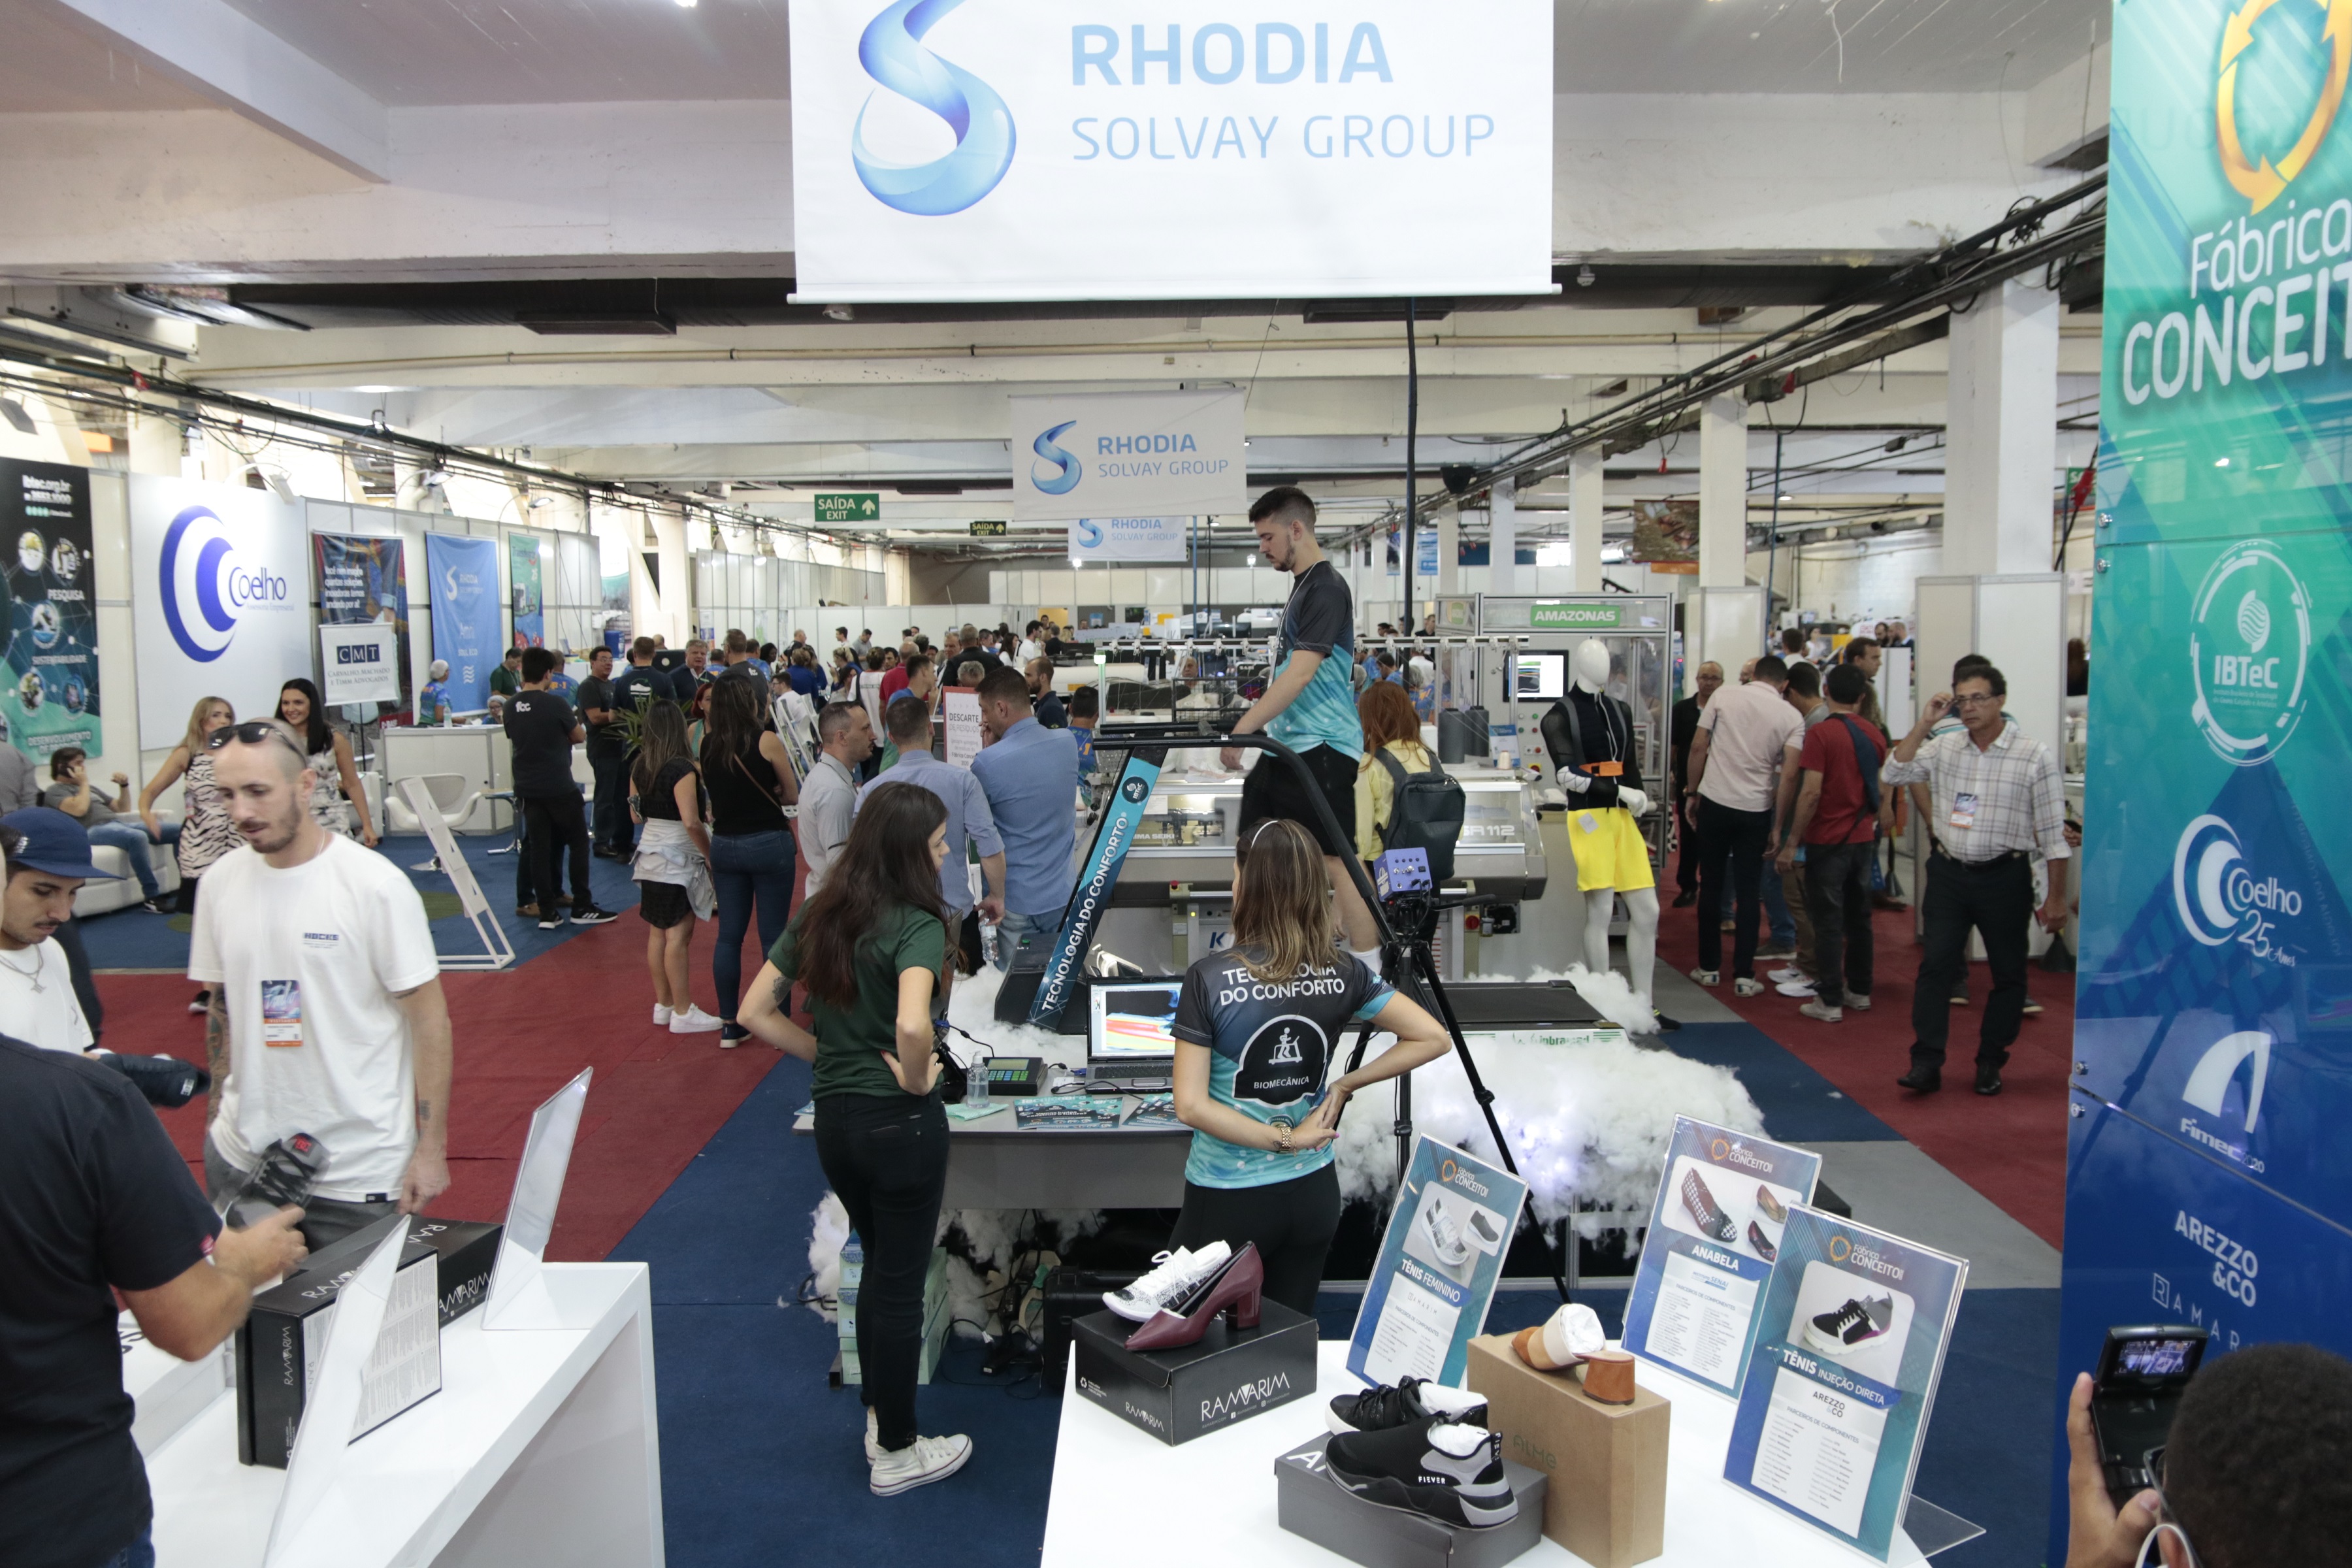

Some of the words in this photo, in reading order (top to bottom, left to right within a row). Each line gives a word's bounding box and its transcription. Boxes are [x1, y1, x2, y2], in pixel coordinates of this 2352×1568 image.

[1071, 22, 1394, 86] RHODIA
[1072, 116, 1278, 161] SOLVAY
[1304, 114, 1495, 159] GROUP
[2191, 199, 2352, 299] Fábrica
[1098, 434, 1197, 455] RHODIA
[1099, 462, 1162, 478] SOLVAY
[1169, 459, 1228, 476] GROUP
[818, 496, 856, 510] SAÍDA
[826, 511, 848, 520] EXIT
[972, 522, 994, 531] SAÍDA
[1111, 519, 1162, 530] RHODIA
[1112, 532, 1146, 541] SOLVAY
[1147, 532, 1178, 541] GROUP
[47, 589, 85, 602] PESQUISA
[229, 566, 286, 607] Coelho
[1534, 610, 1616, 622] AMAZONAS
[338, 646, 377, 662] CMT
[2214, 655, 2279, 689] IBTeC
[515, 701, 531, 712] fcc
[949, 713, 979, 723] DESCARTE
[1486, 825, 1515, 836] 112
[2227, 868, 2302, 916] Coelho
[1042, 922, 1088, 1011] TECNOLOGIA
[1079, 898, 1096, 922] DO
[1089, 817, 1128, 897] CONFORTO
[2238, 909, 2276, 957] 25
[1220, 987, 1249, 1006] DO
[1252, 978, 1345, 1001] CONFORTO
[1254, 1076, 1309, 1089] BIOMECÂNICA
[2181, 1118, 2242, 1162] Fimec
[1729, 1152, 1769, 1172] CONCEITO
[1455, 1174, 1486, 1196] CONCEITO
[1691, 1245, 1739, 1271] ANABELA
[2174, 1210, 2259, 1279] AREZZO
[1851, 1252, 1900, 1279] CONCEITO
[439, 1272, 491, 1313] AMARIM
[1402, 1258, 1423, 1281] TÊNIS
[1423, 1271, 1461, 1303] FEMININO
[1711, 1276, 1729, 1287] SENAI
[2213, 1262, 2257, 1307] &CO
[1676, 1283, 1698, 1296] PARCEIROS
[1704, 1294, 1736, 1311] COMPONENTES
[282, 1326, 293, 1386] RAMARIM
[1783, 1348, 1817, 1375] TÊNIS
[1818, 1367, 1854, 1390] INJEÇÃO
[1855, 1384, 1885, 1406] DIRETA
[1201, 1371, 1290, 1422] RAMARIM
[1813, 1391, 1845, 1411] AREZZO
[1126, 1401, 1164, 1432] RAMARIM
[1787, 1406, 1813, 1422] PARCEIROS
[1821, 1422, 1859, 1444] COMPONENTES
[1418, 1476, 1446, 1484] FIEVER
